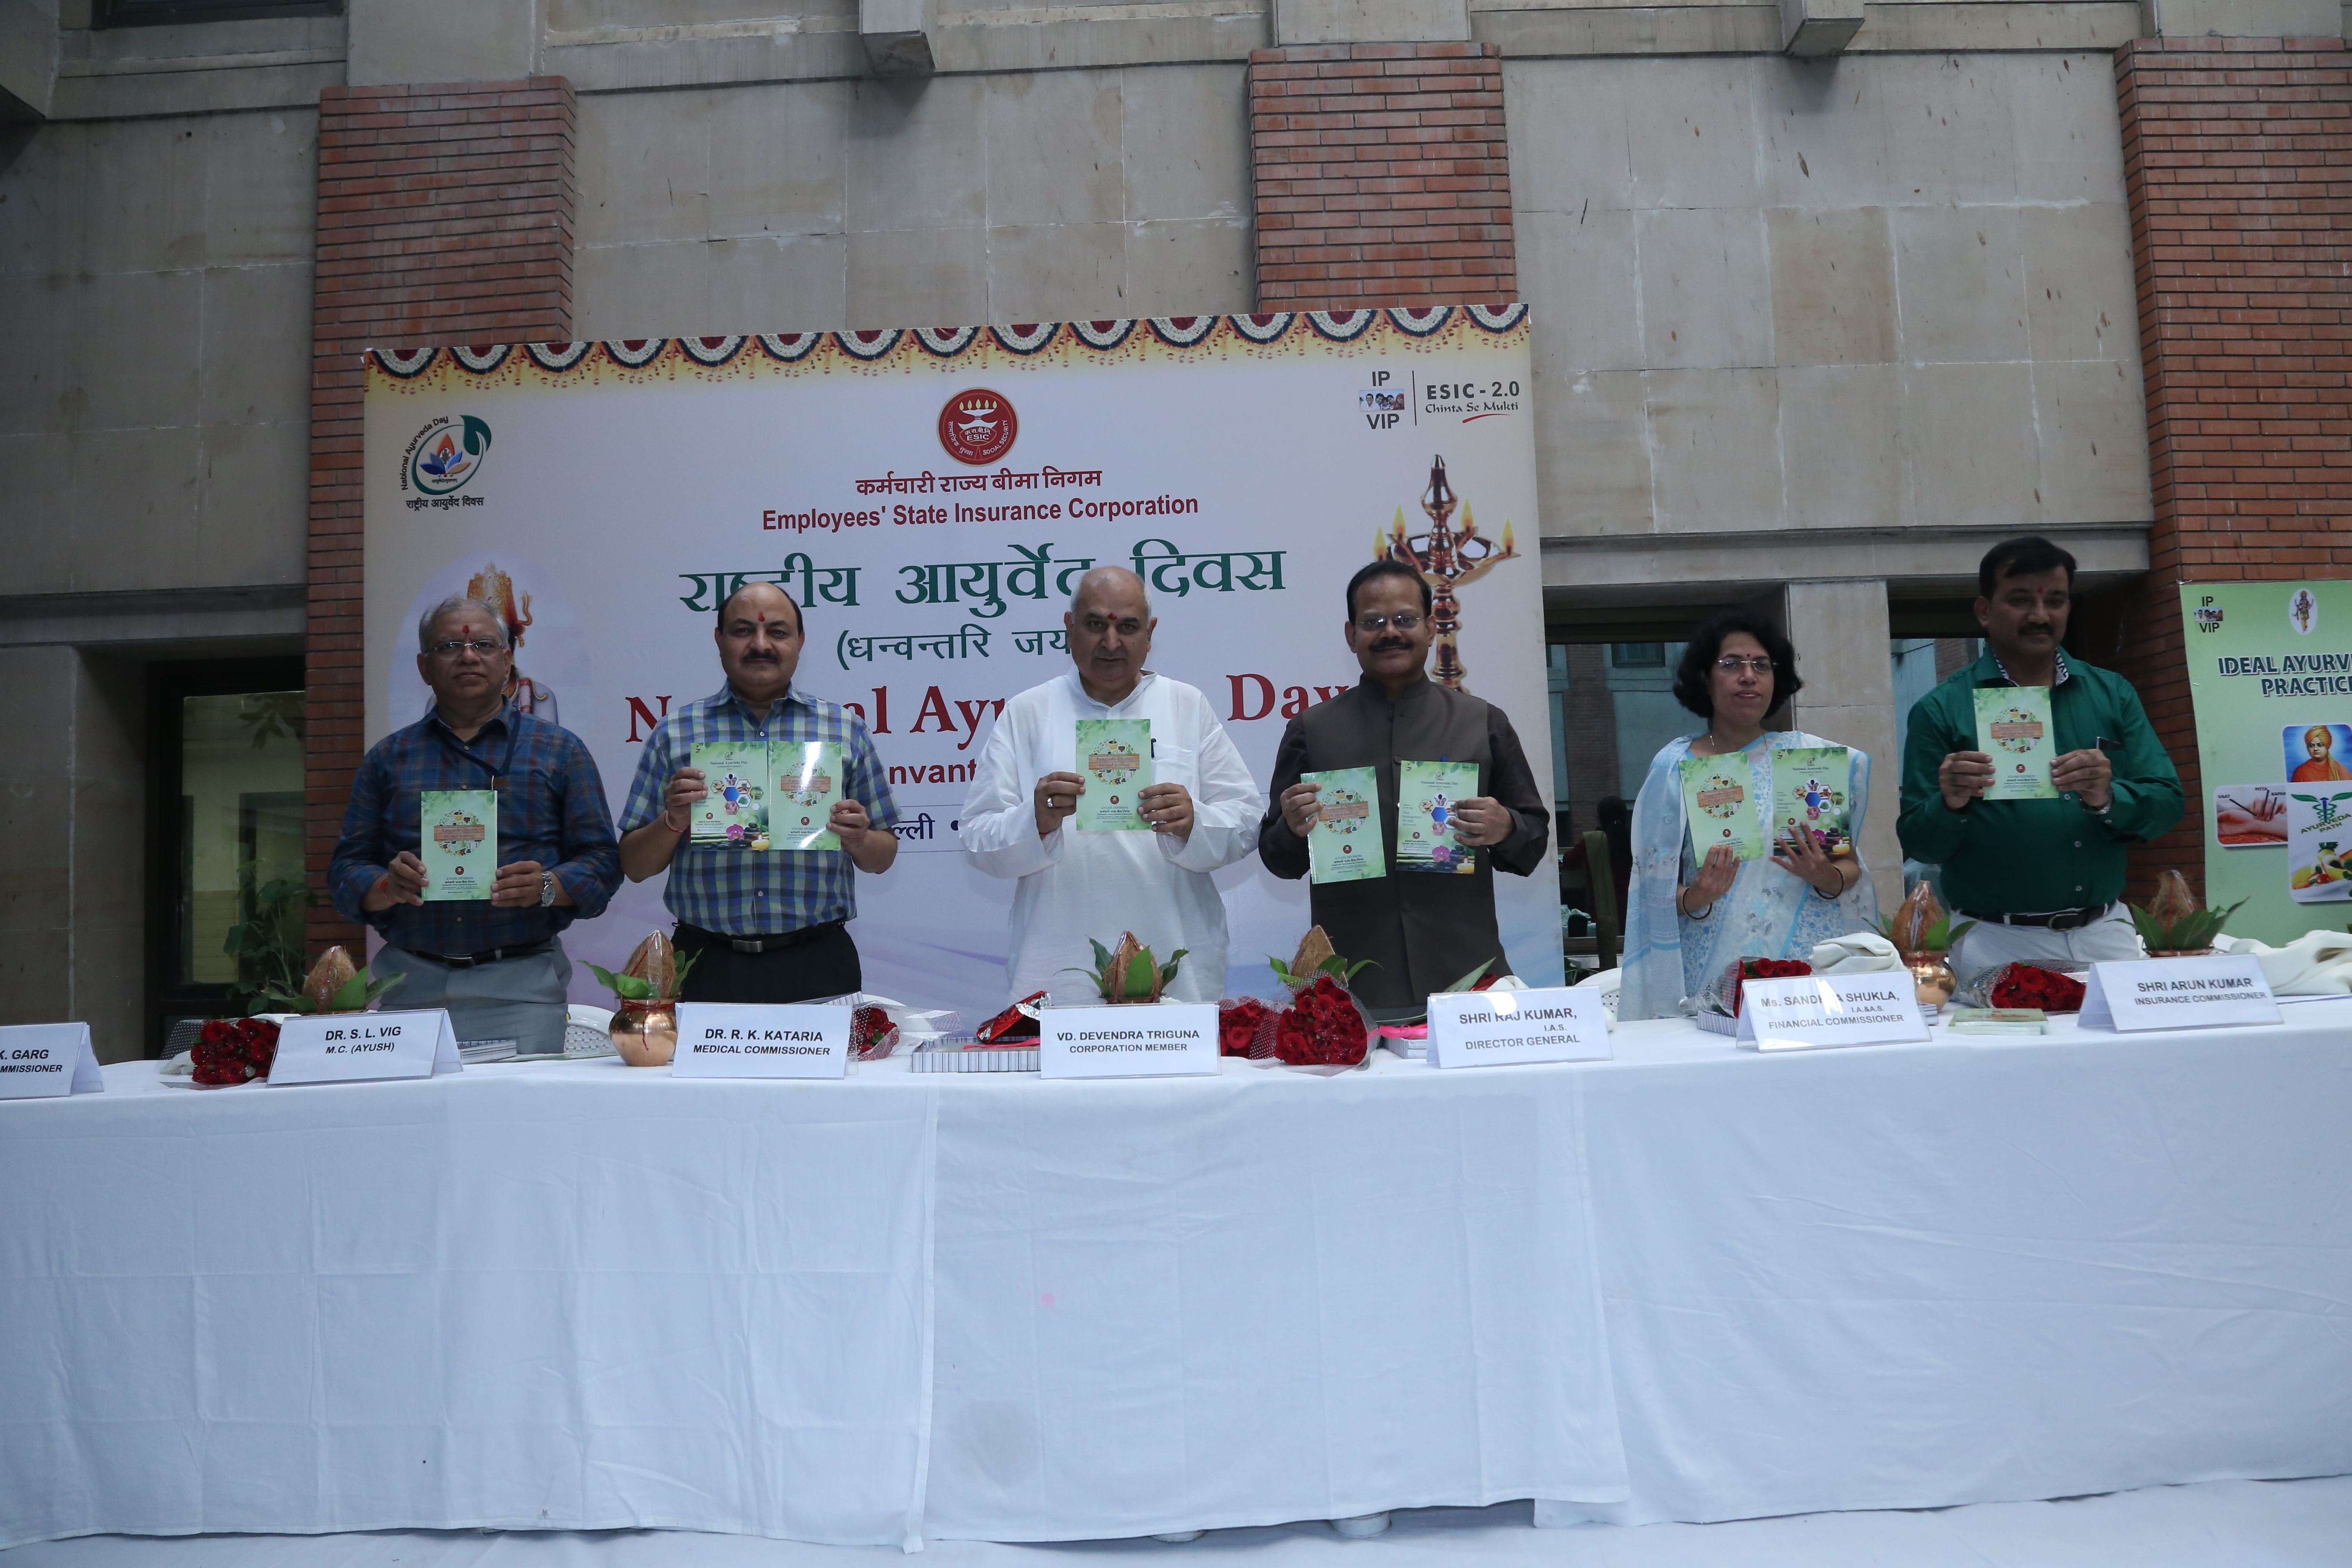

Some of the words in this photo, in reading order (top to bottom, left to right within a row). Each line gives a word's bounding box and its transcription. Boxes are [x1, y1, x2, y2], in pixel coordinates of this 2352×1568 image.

[1372, 371, 1390, 386] IP
[1427, 383, 1475, 400] ESIC
[1492, 381, 1520, 397] 2.0
[1425, 403, 1463, 413] Chinta
[1467, 402, 1479, 412] Se
[1483, 401, 1518, 411] Mukti
[1366, 413, 1400, 429] VIP
[983, 444, 1001, 455] SOCIAL
[999, 420, 1009, 445] SECURITY
[400, 456, 409, 490] National
[405, 423, 433, 455] Ayurveda
[432, 416, 448, 426] Day
[855, 471, 935, 495] कर्मचारी
[939, 475, 988, 493] राज्य
[991, 467, 1039, 490] बीमा
[1042, 466, 1102, 488] निगम
[406, 497, 429, 511] राष्ट्रीय
[431, 495, 460, 510] आयुर्वेद
[462, 495, 484, 506] दिवस
[763, 506, 886, 533] Employees'
[893, 504, 948, 525] State
[955, 502, 1061, 523] Insurance
[1069, 494, 1198, 522] Corporation
[1129, 539, 1286, 597] दिवस
[2202, 596, 2214, 606] IP
[2199, 622, 2220, 633] VIP
[2218, 655, 2280, 676] IDEAL
[2300, 813, 2352, 833] AYURVEDA
[2319, 822, 2342, 833] PATH
[2137, 982, 2168, 992] SHRI
[2171, 980, 2206, 990] ARUN
[2208, 978, 2254, 989] KUMAR
[1761, 998, 1781, 1007] Ms.
[1847, 991, 1900, 1002] SHUKLA,
[2134, 995, 2191, 1005] INSURANCE
[2193, 992, 2268, 1003] COMMISSIONER
[1459, 1013, 1491, 1024] SHRI
[1524, 1008, 1577, 1020] KUMAR,
[1768, 1019, 1824, 1029] FINANCIAL
[1825, 1014, 1904, 1026] COMMISSIONER
[325, 1030, 346, 1040] DR.
[350, 1029, 361, 1039] S.
[365, 1028, 375, 1038] L.
[380, 1026, 401, 1037] VIG
[705, 1029, 726, 1039] DR.
[731, 1029, 743, 1040] R.
[748, 1030, 760, 1040] K.
[764, 1031, 823, 1042] KATARIA
[1057, 1032, 1076, 1041] VD.
[1080, 1031, 1144, 1041] DEVENDRA
[1146, 1030, 1200, 1039] TRIGUNA
[325, 1045, 348, 1054] M.C.
[351, 1042, 395, 1054] (AYUSH)
[693, 1045, 741, 1054] MEDICAL
[744, 1046, 830, 1055] COMMISSIONER
[1069, 1044, 1142, 1053] CORPORATION
[1465, 1038, 1524, 1050] DIRECTOR
[1527, 1035, 1580, 1046] GENERAL
[12, 1049, 49, 1060] GARG
[0, 1065, 63, 1073] MMISSIONER
